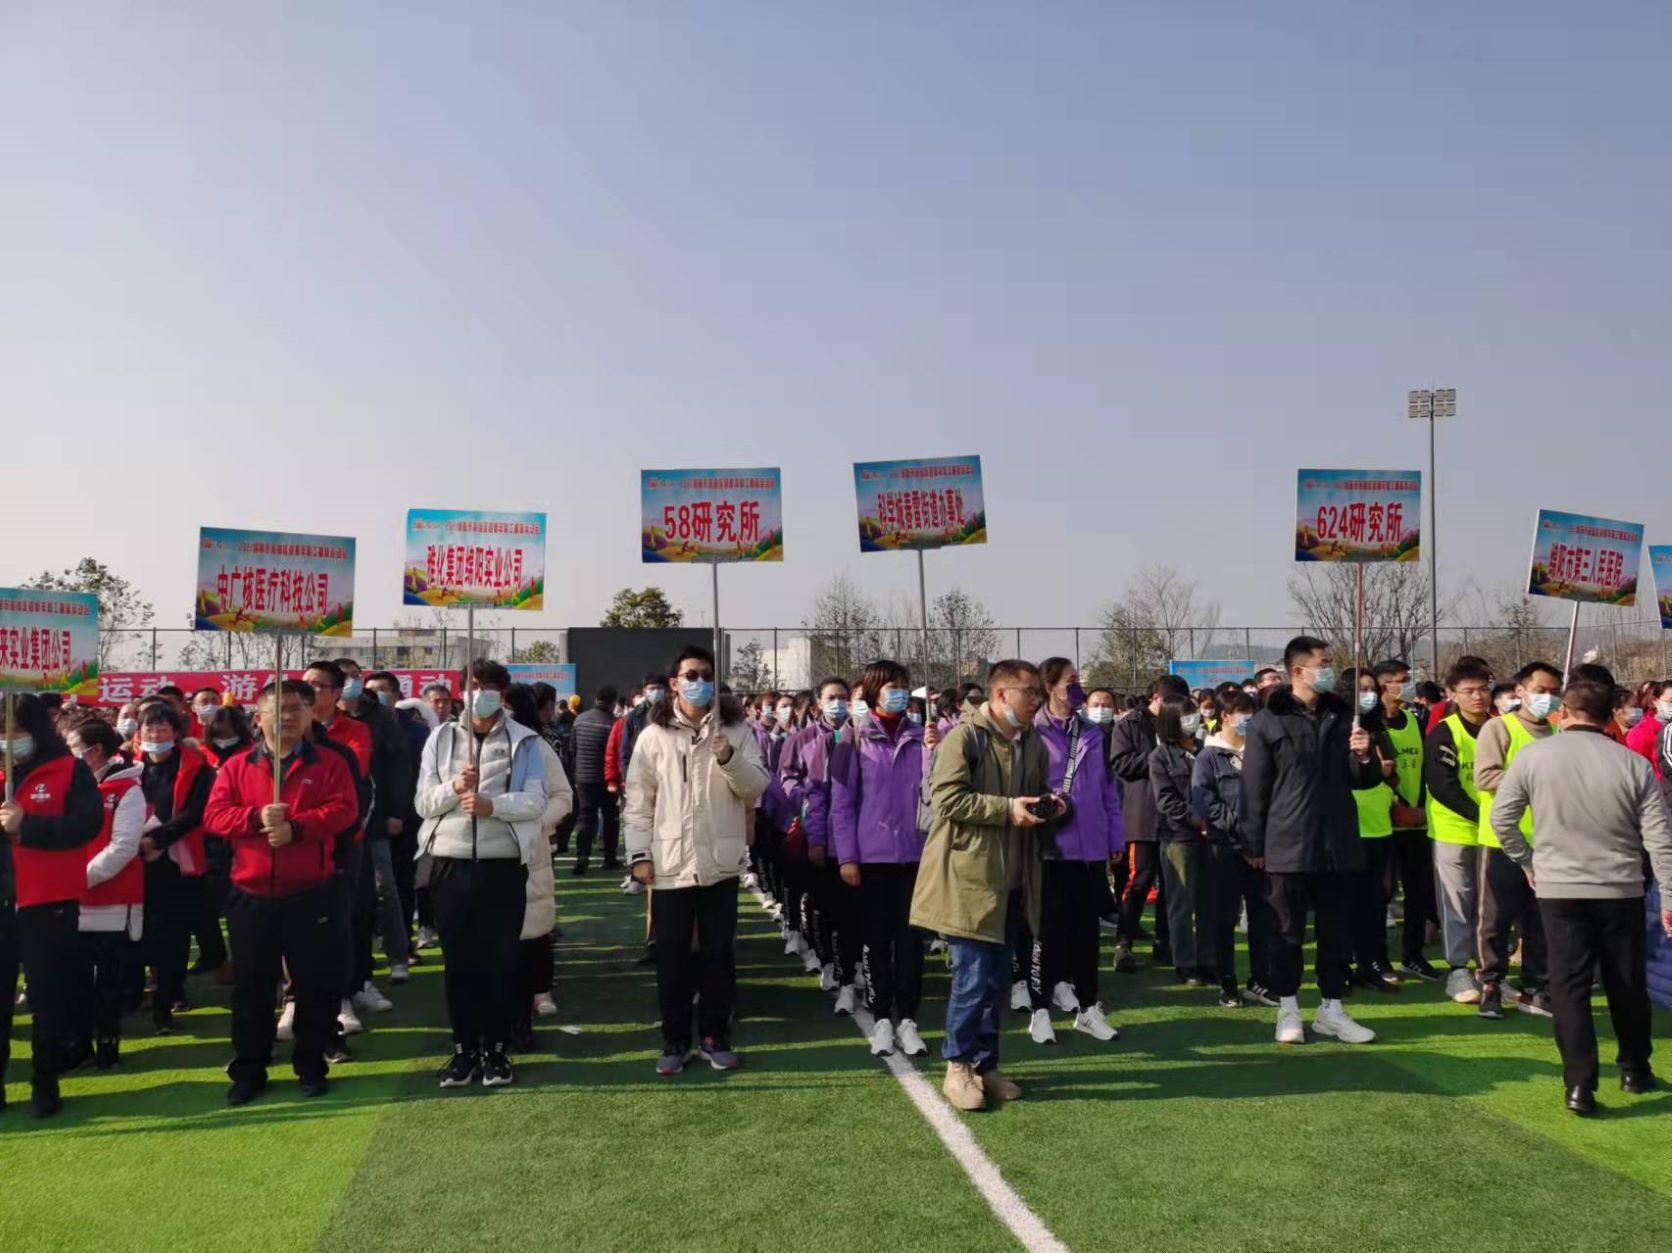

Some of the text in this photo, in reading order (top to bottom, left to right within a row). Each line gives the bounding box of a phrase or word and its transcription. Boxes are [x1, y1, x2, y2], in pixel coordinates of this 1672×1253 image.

[663, 501, 760, 543] 58研究所
[1316, 501, 1403, 543] 624研究所
[426, 544, 522, 591] 雅化集团绵阳实业公司
[1548, 541, 1624, 588] 绵阳市第三人民医院
[217, 564, 328, 616] 中广核医疗科技公司
